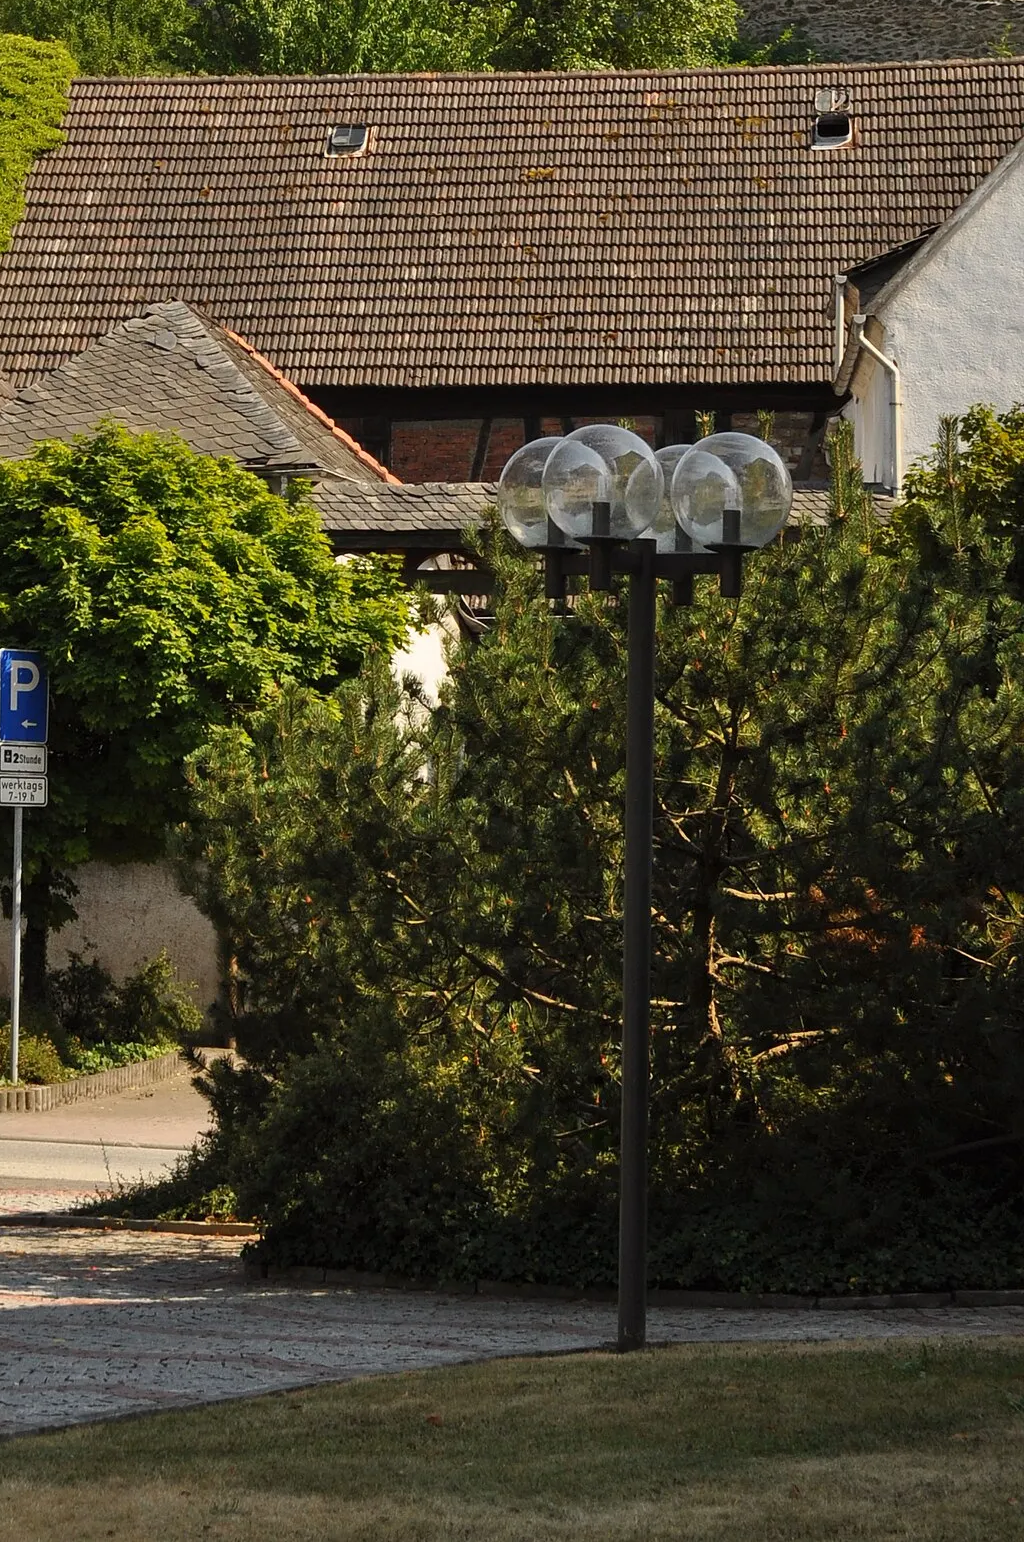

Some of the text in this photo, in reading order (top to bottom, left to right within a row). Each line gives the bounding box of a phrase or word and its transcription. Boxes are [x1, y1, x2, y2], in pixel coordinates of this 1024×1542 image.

[10, 659, 40, 711] P
[2, 779, 43, 792] werktags
[30, 792, 35, 801] h
